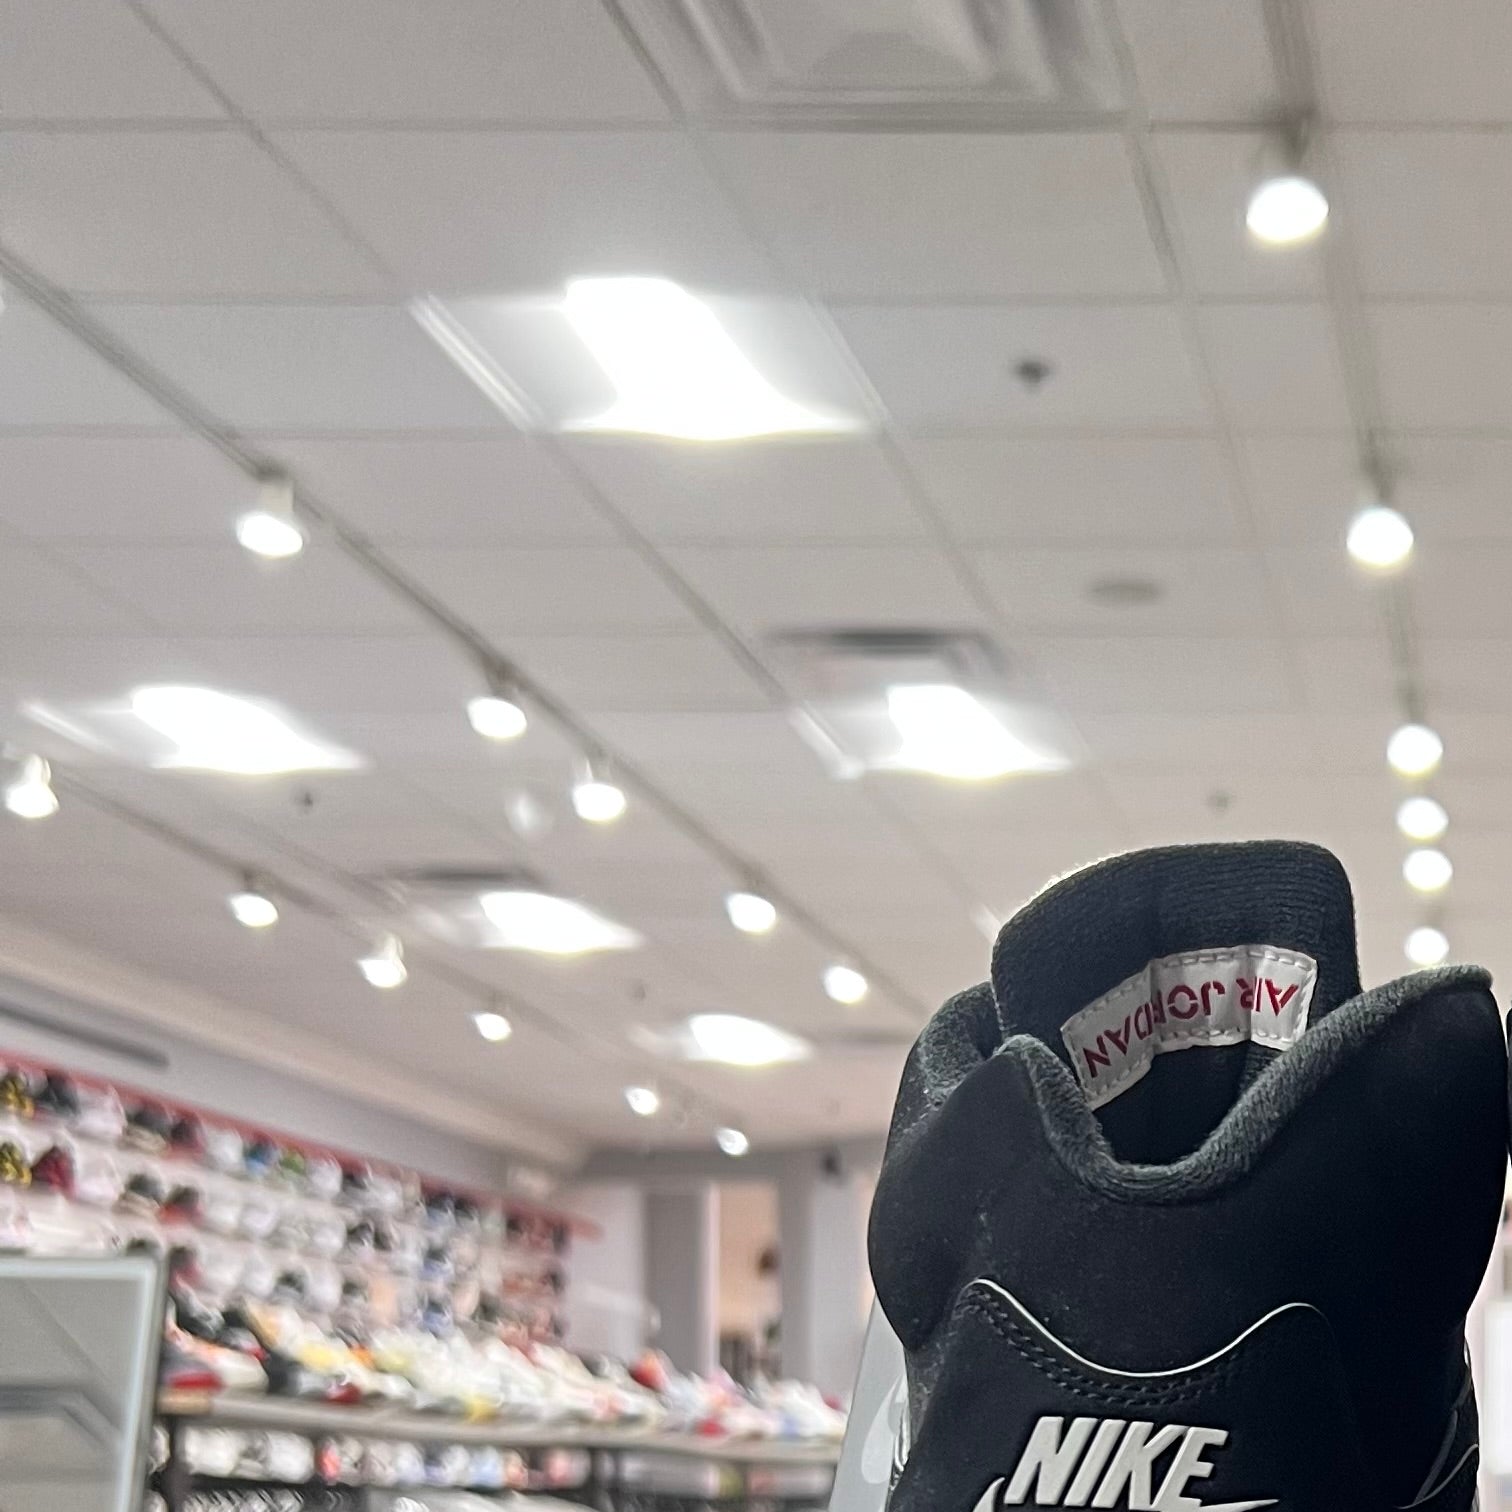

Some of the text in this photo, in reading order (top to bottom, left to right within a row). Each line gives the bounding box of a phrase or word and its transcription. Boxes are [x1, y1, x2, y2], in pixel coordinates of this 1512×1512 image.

[1083, 976, 1299, 1078] AIR JORDAN
[1003, 1416, 1229, 1511] NIKE
